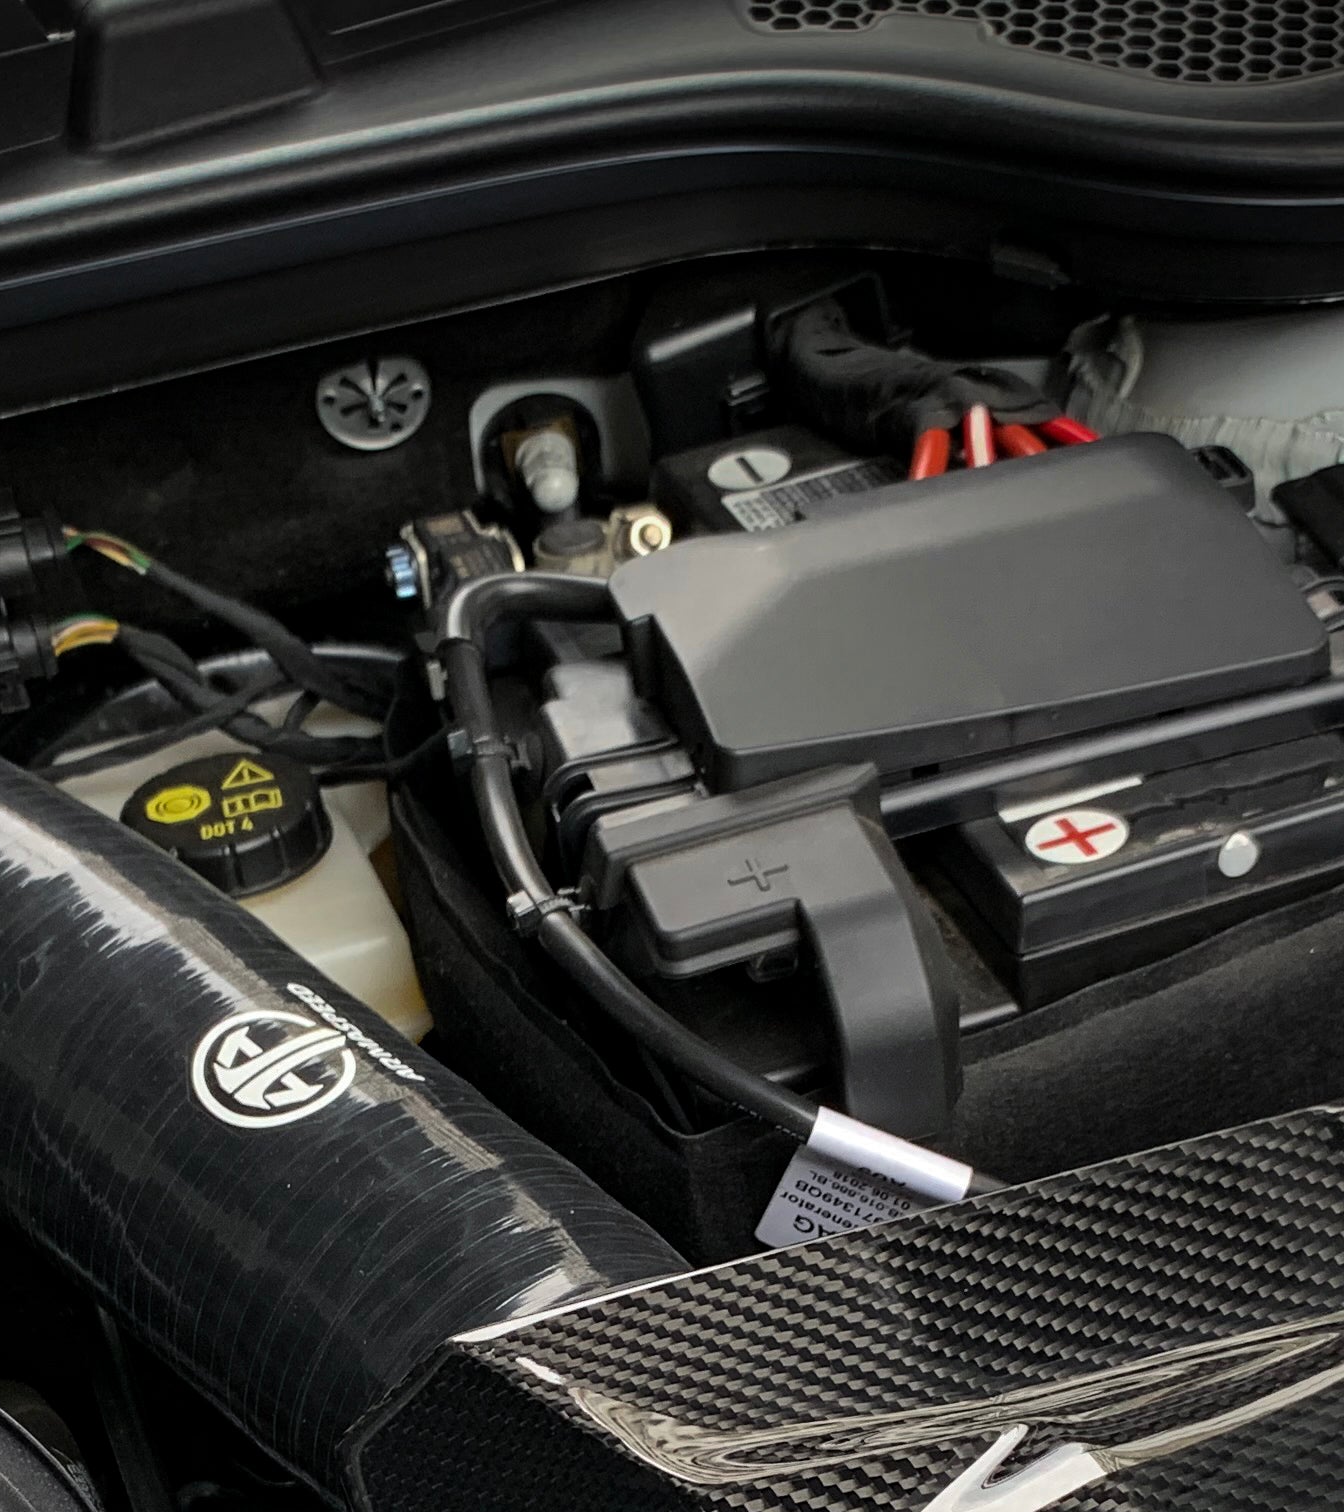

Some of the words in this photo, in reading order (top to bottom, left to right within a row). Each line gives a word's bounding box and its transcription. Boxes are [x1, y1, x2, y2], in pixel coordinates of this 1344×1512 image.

[200, 822, 235, 841] DOT
[239, 818, 254, 834] 4
[779, 1191, 859, 1229] enerator
